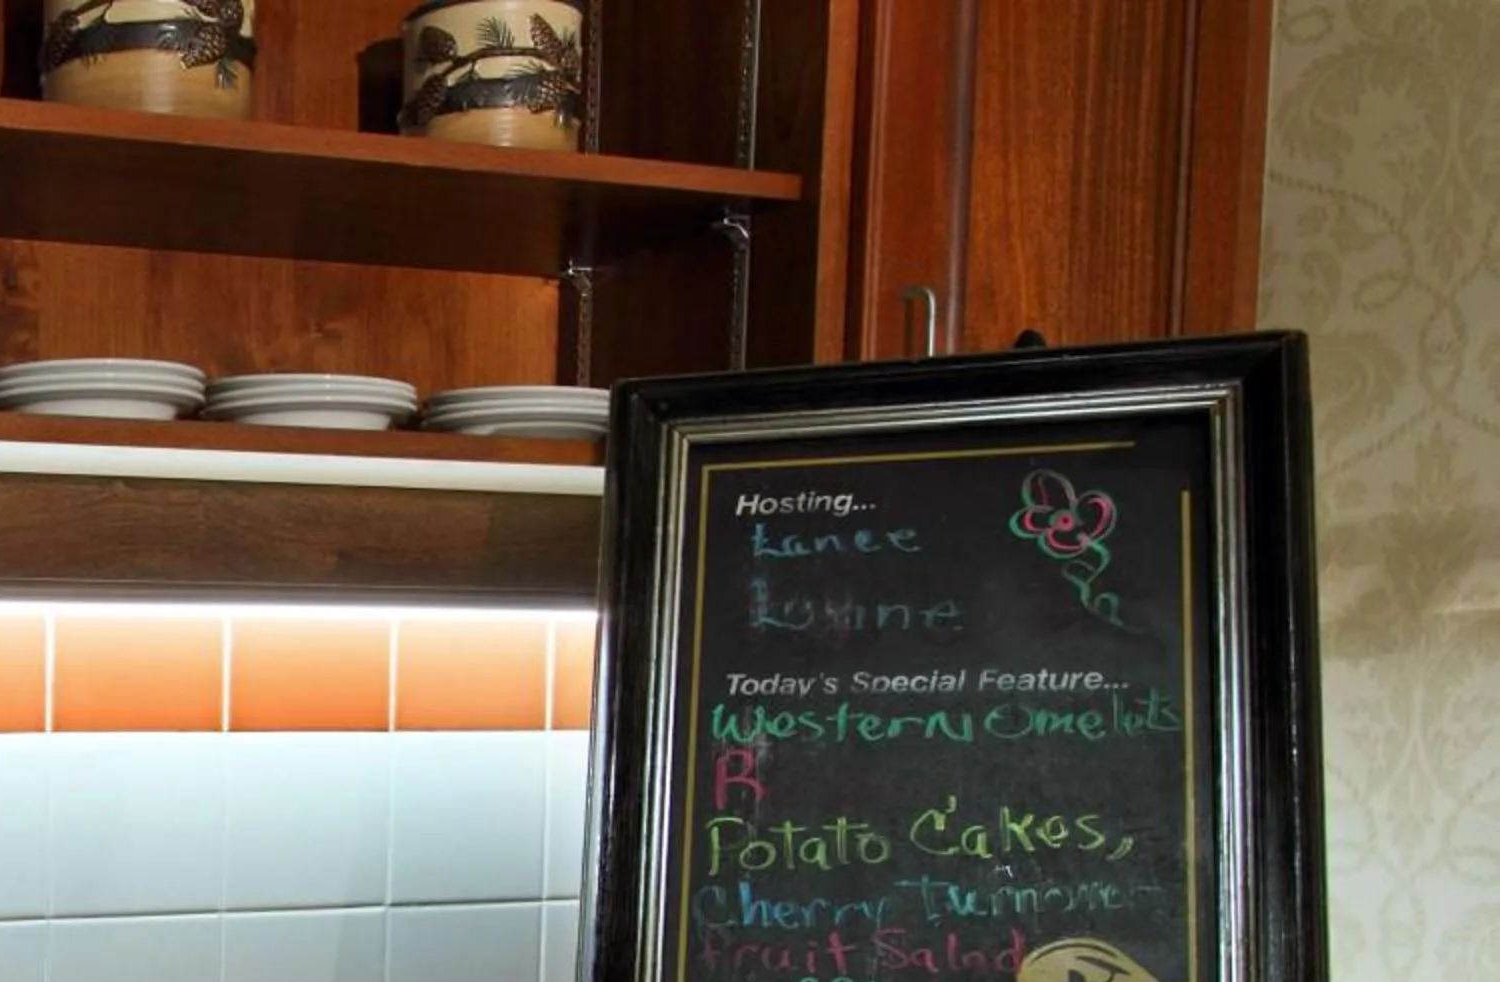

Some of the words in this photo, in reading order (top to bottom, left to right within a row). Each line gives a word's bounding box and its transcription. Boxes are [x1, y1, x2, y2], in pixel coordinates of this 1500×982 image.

[726, 672, 838, 698] Today's
[850, 669, 965, 695] Special
[706, 816, 892, 876] Potato
[693, 878, 887, 935] Cherry
